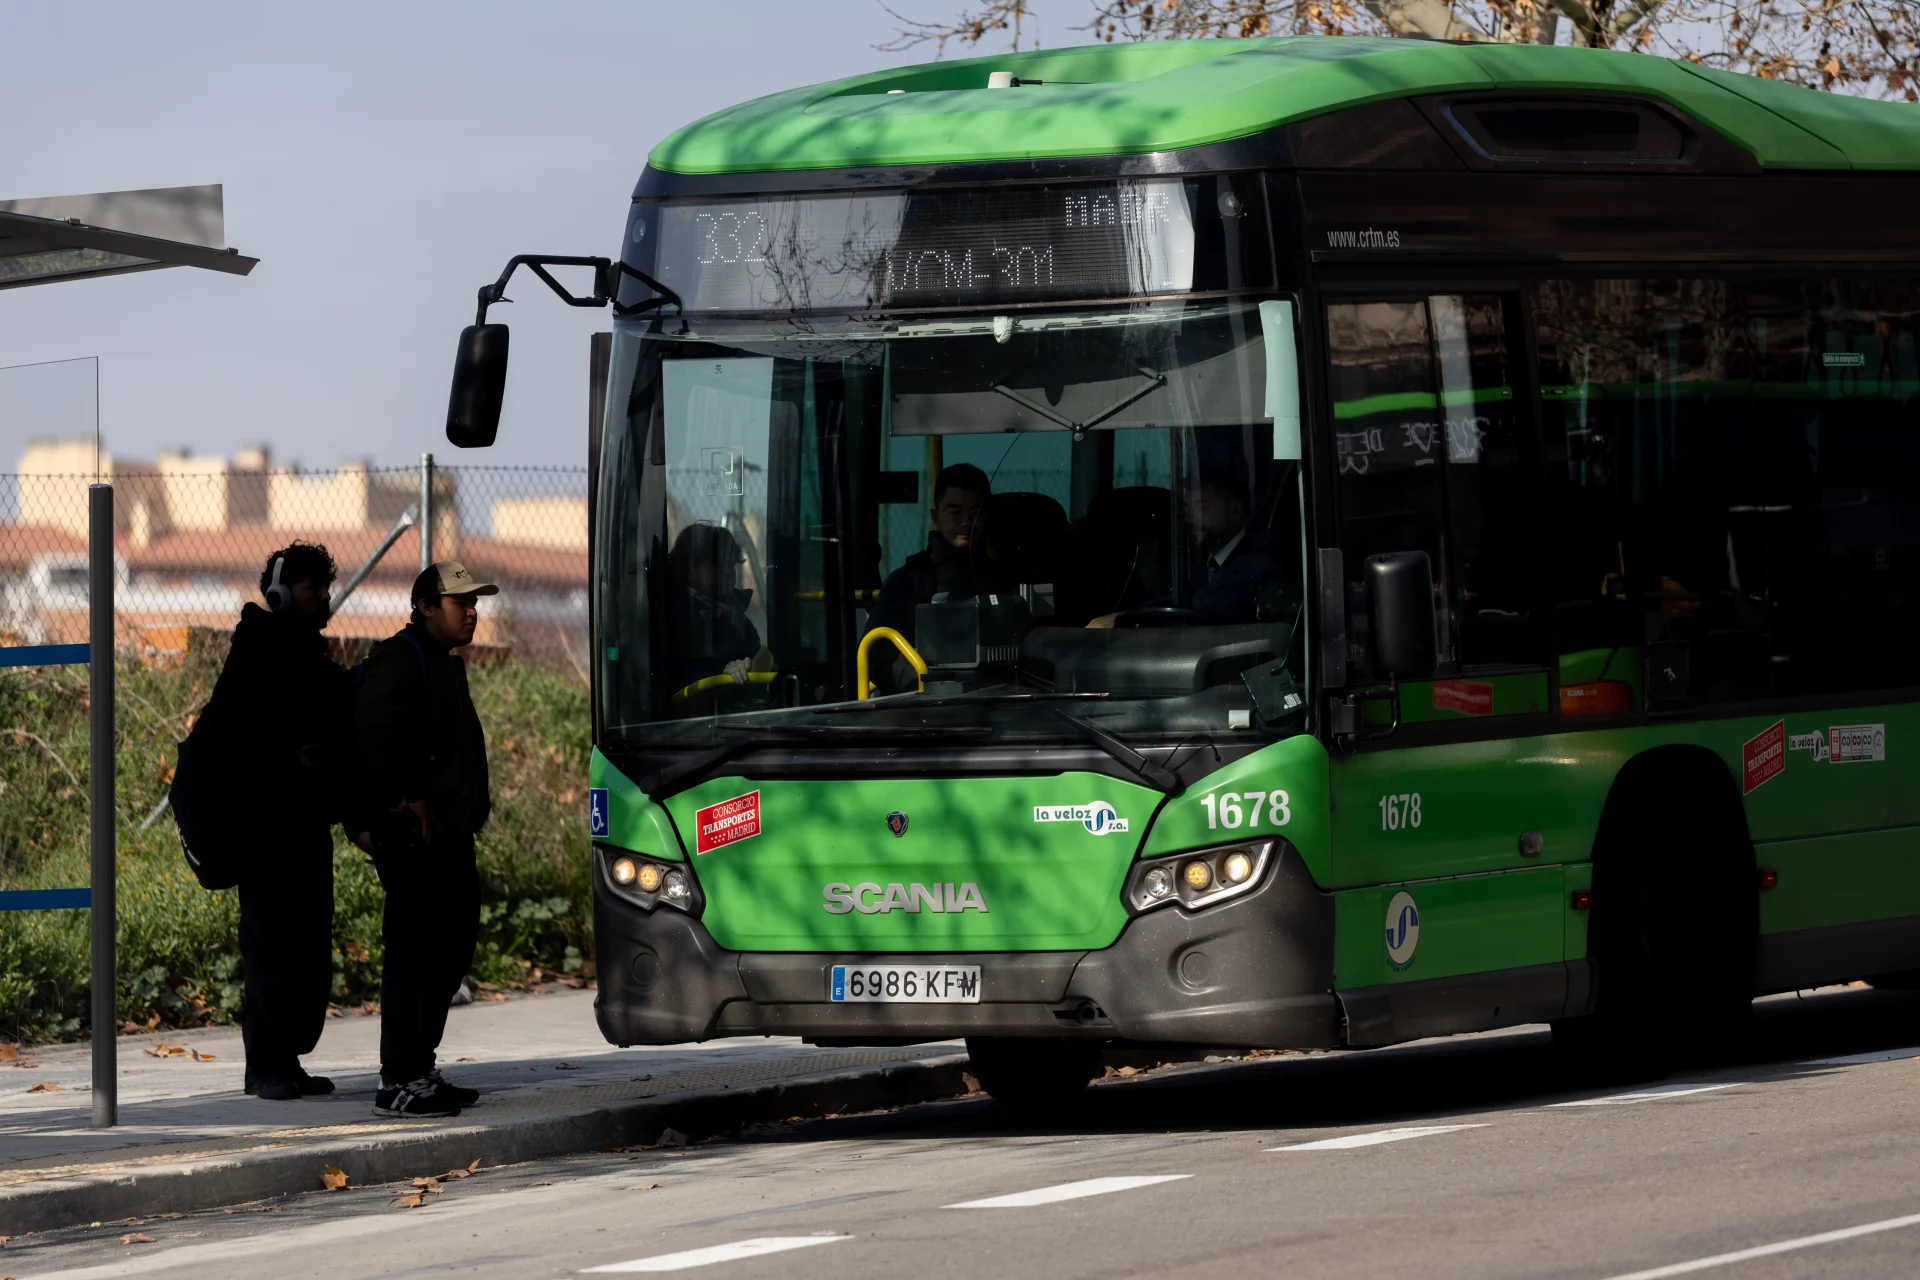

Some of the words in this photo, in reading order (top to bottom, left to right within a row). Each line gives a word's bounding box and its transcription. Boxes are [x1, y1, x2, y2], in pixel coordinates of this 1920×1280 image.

[696, 211, 765, 264] 332
[1326, 226, 1400, 248] www.crtm.es
[1754, 726, 1783, 753] CONSORCIO
[1798, 735, 1814, 748] veloz
[1747, 741, 1783, 772] TRANSPORTES
[1763, 756, 1783, 778] MADRID
[712, 796, 756, 819] CONSORCIO
[1036, 808, 1049, 820] la
[1054, 807, 1092, 820] veloz
[1200, 789, 1291, 830] 1678
[1378, 792, 1422, 831] 1678
[703, 809, 756, 836] TRANSPORTES
[727, 821, 756, 841] MADRID
[822, 882, 990, 915] SCANIA
[835, 987, 842, 996] E
[850, 970, 918, 997] 6986
[926, 970, 977, 998] KFM
